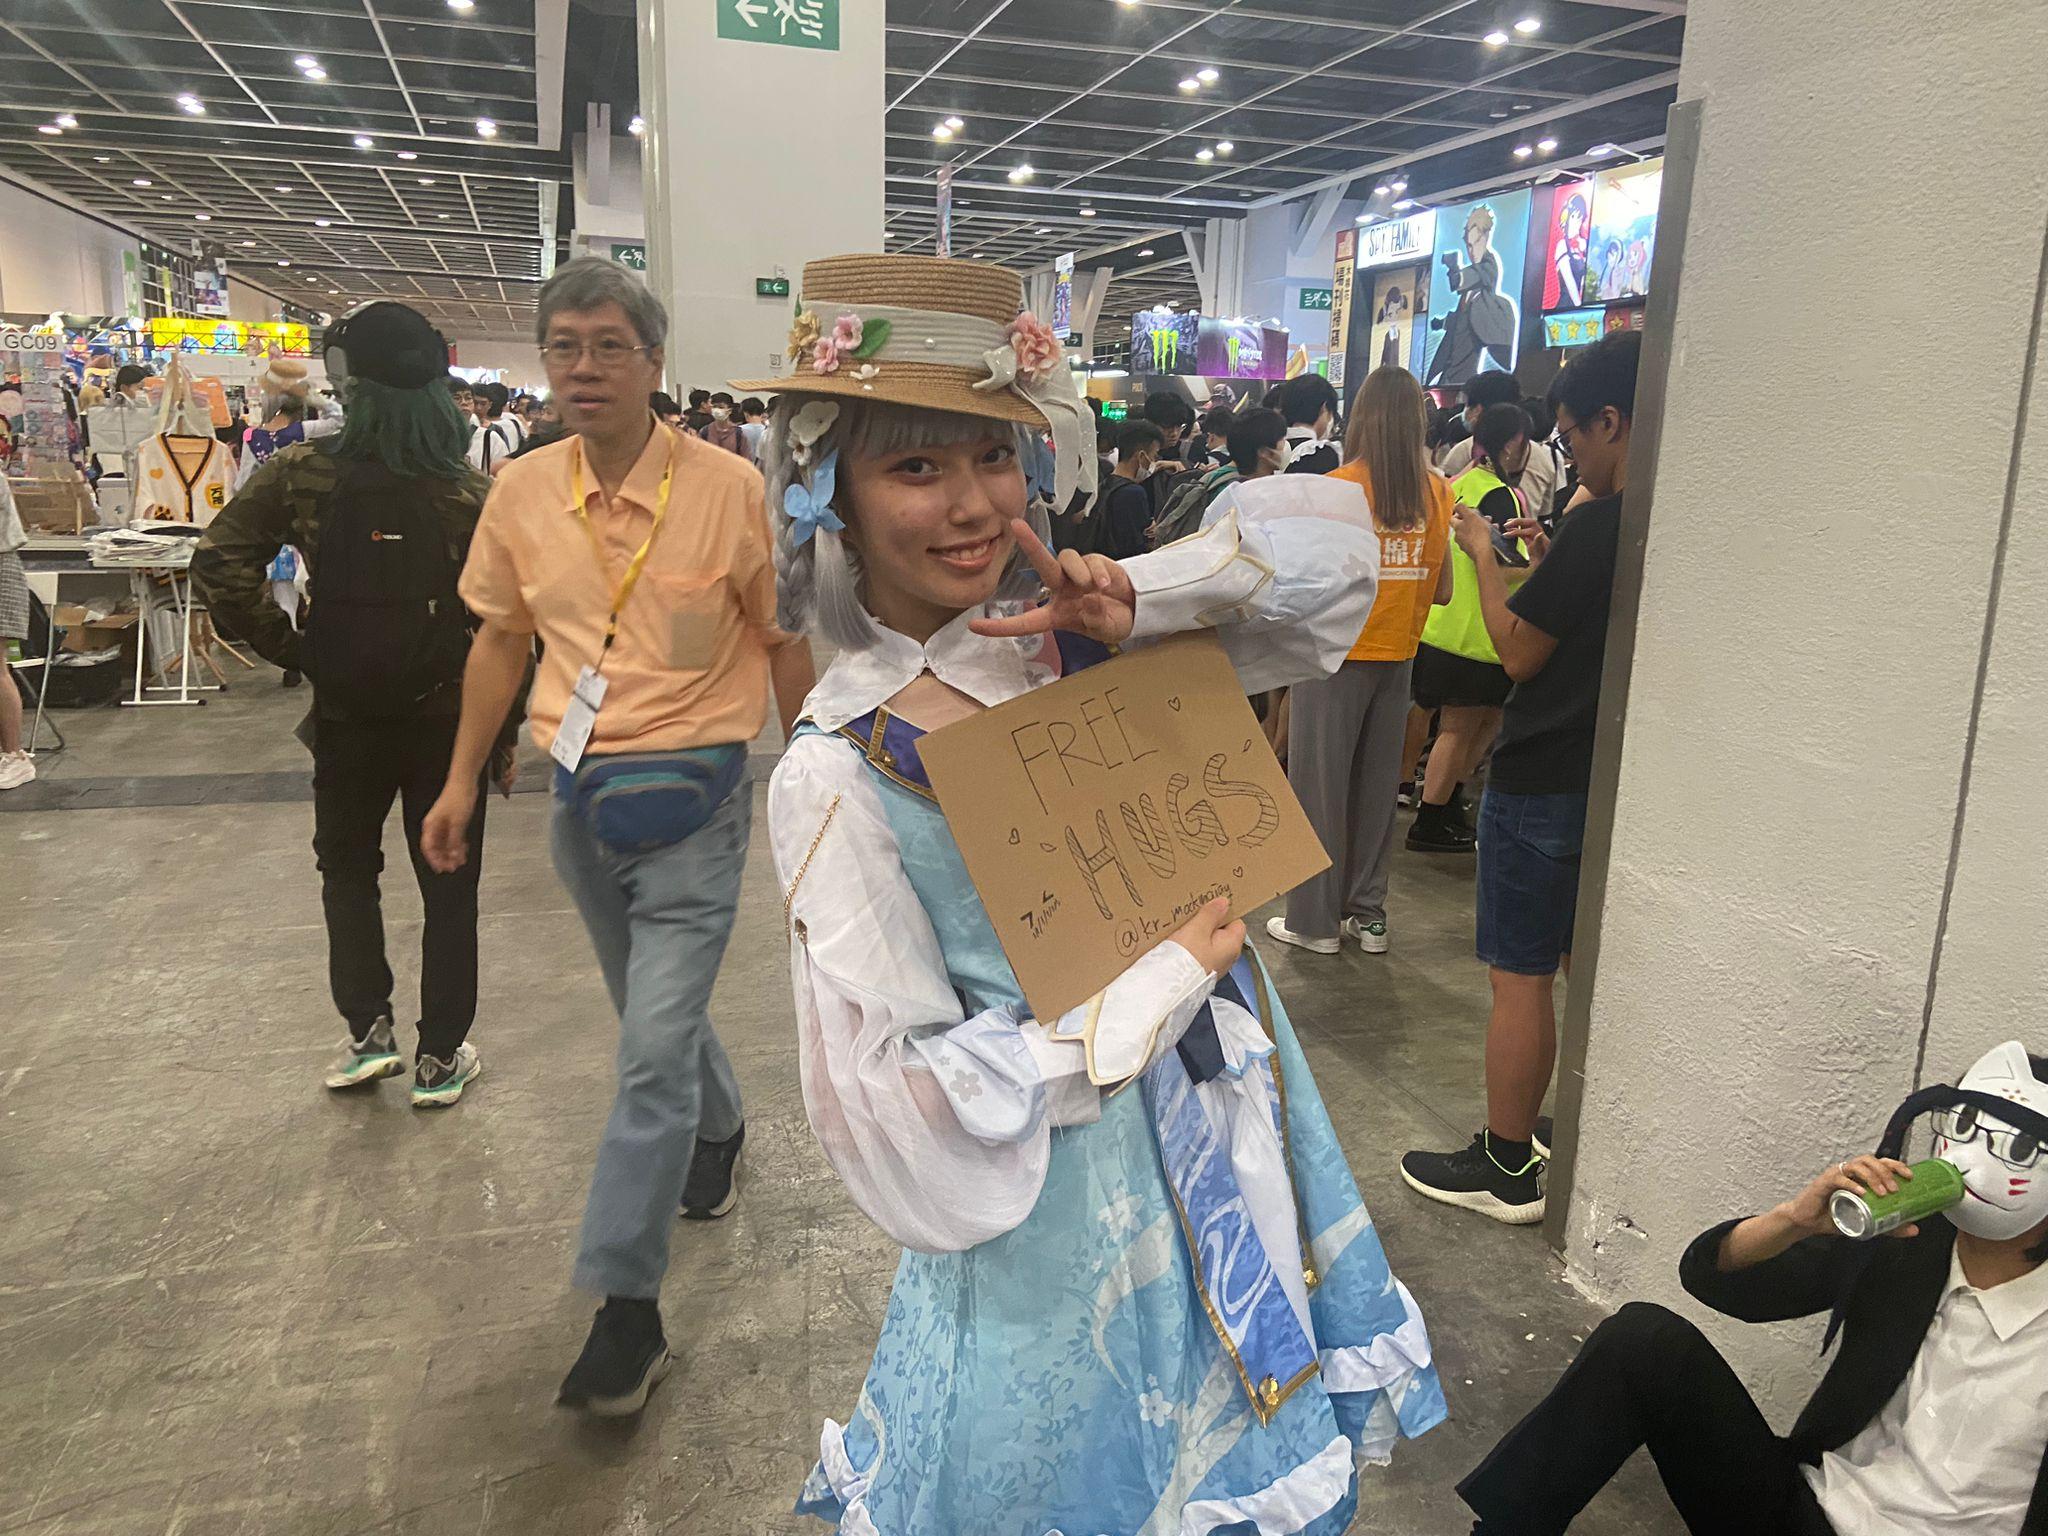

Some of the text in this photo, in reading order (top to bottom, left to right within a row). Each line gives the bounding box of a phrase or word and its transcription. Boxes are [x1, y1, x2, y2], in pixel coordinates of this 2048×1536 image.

[4, 334, 57, 350] GC09
[158, 320, 202, 331] PIAR
[1010, 686, 1159, 816] FREE
[1065, 752, 1280, 920] HUGS
